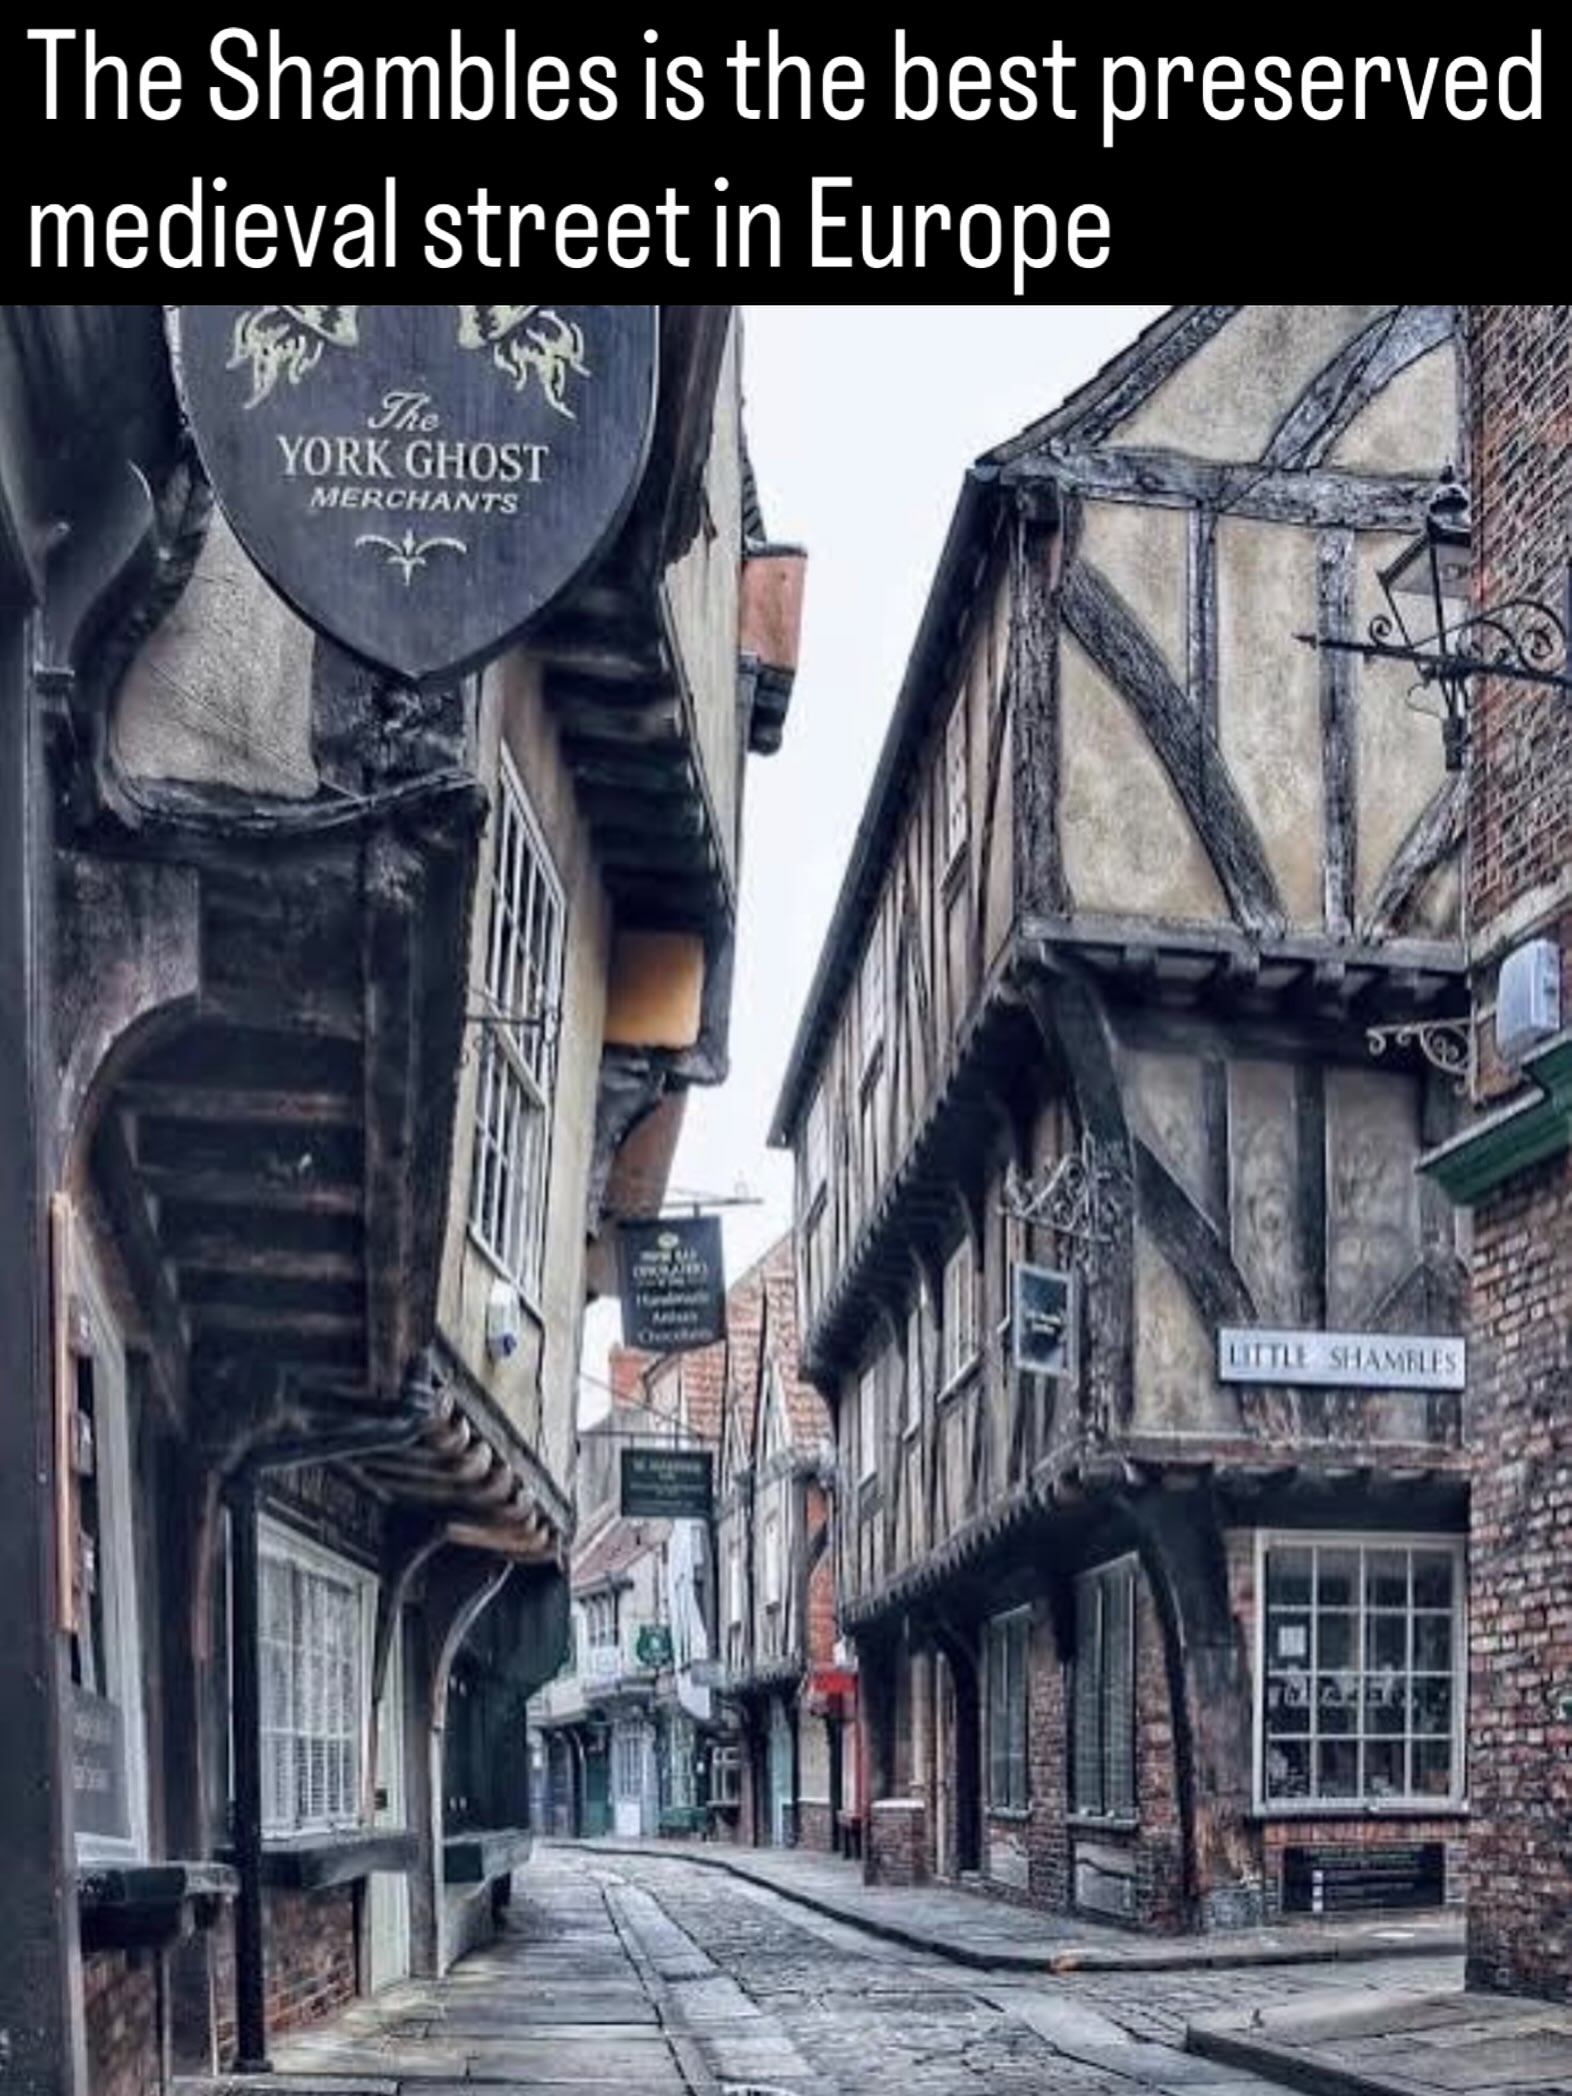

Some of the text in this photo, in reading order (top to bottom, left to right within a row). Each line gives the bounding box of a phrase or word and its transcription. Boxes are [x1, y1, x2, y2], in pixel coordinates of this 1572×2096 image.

[368, 392, 440, 432] The
[277, 436, 549, 483] YORK GHOST
[309, 487, 519, 514] MERCHANTS
[1230, 1343, 1458, 1375] LITTLE SHAMBLES
